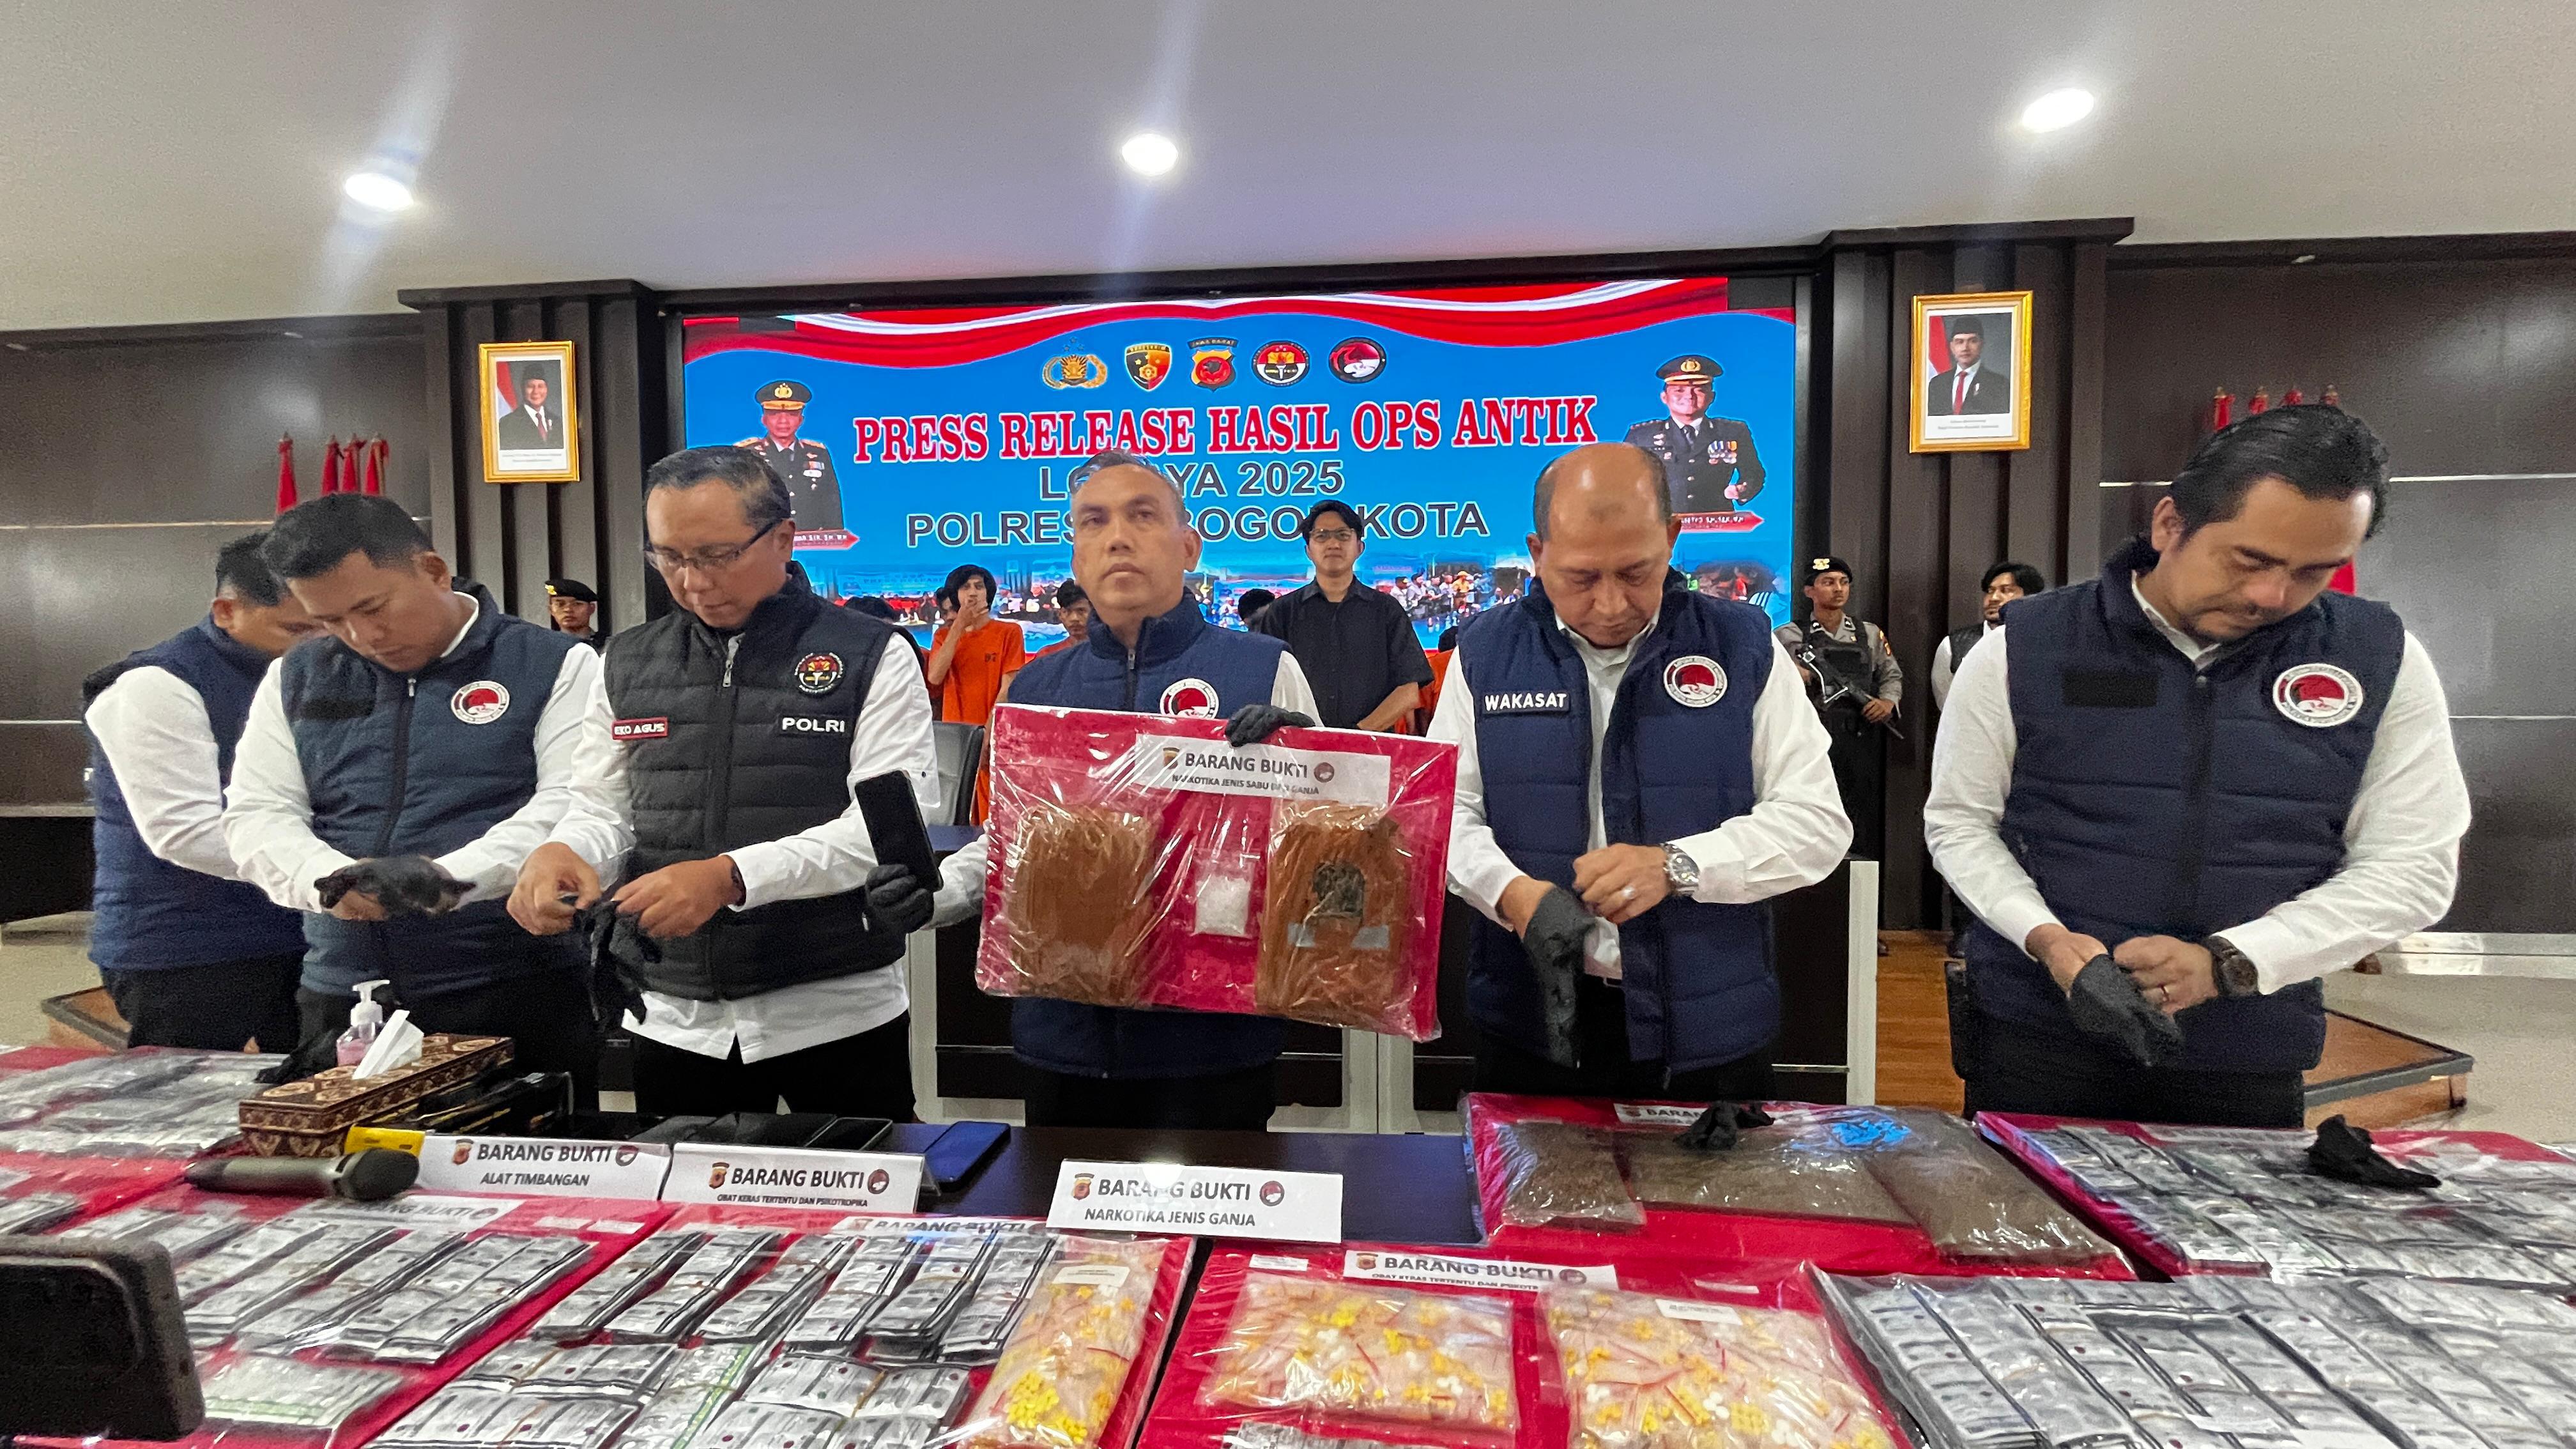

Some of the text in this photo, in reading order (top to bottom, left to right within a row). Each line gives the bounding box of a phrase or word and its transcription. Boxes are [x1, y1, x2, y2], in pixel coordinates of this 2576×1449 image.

[854, 396, 1598, 464] PRESS RELEASE HASIL OPS ANTIK
[1238, 461, 1345, 496] 2025
[1356, 501, 1489, 538] KOTA
[1485, 693, 1567, 711] WAKASAT
[614, 723, 665, 735] EKO AGUS
[782, 717, 845, 733] POLRI
[1185, 753, 1308, 778] BARANG BUKTI
[1221, 778, 1245, 788] JENIS
[1646, 1108, 1701, 1118] BARA
[477, 1144, 613, 1163] BARANG BUKTI
[480, 1173, 590, 1186] ALAT TIMBANGAN
[731, 1168, 864, 1189] BARANG BUKTI
[1098, 1179, 1251, 1200] BARAG BUKTI
[1084, 1208, 1256, 1227] NARKOTIKA JENIS GANJA
[1384, 1257, 1553, 1280] BARANG BUKTI
